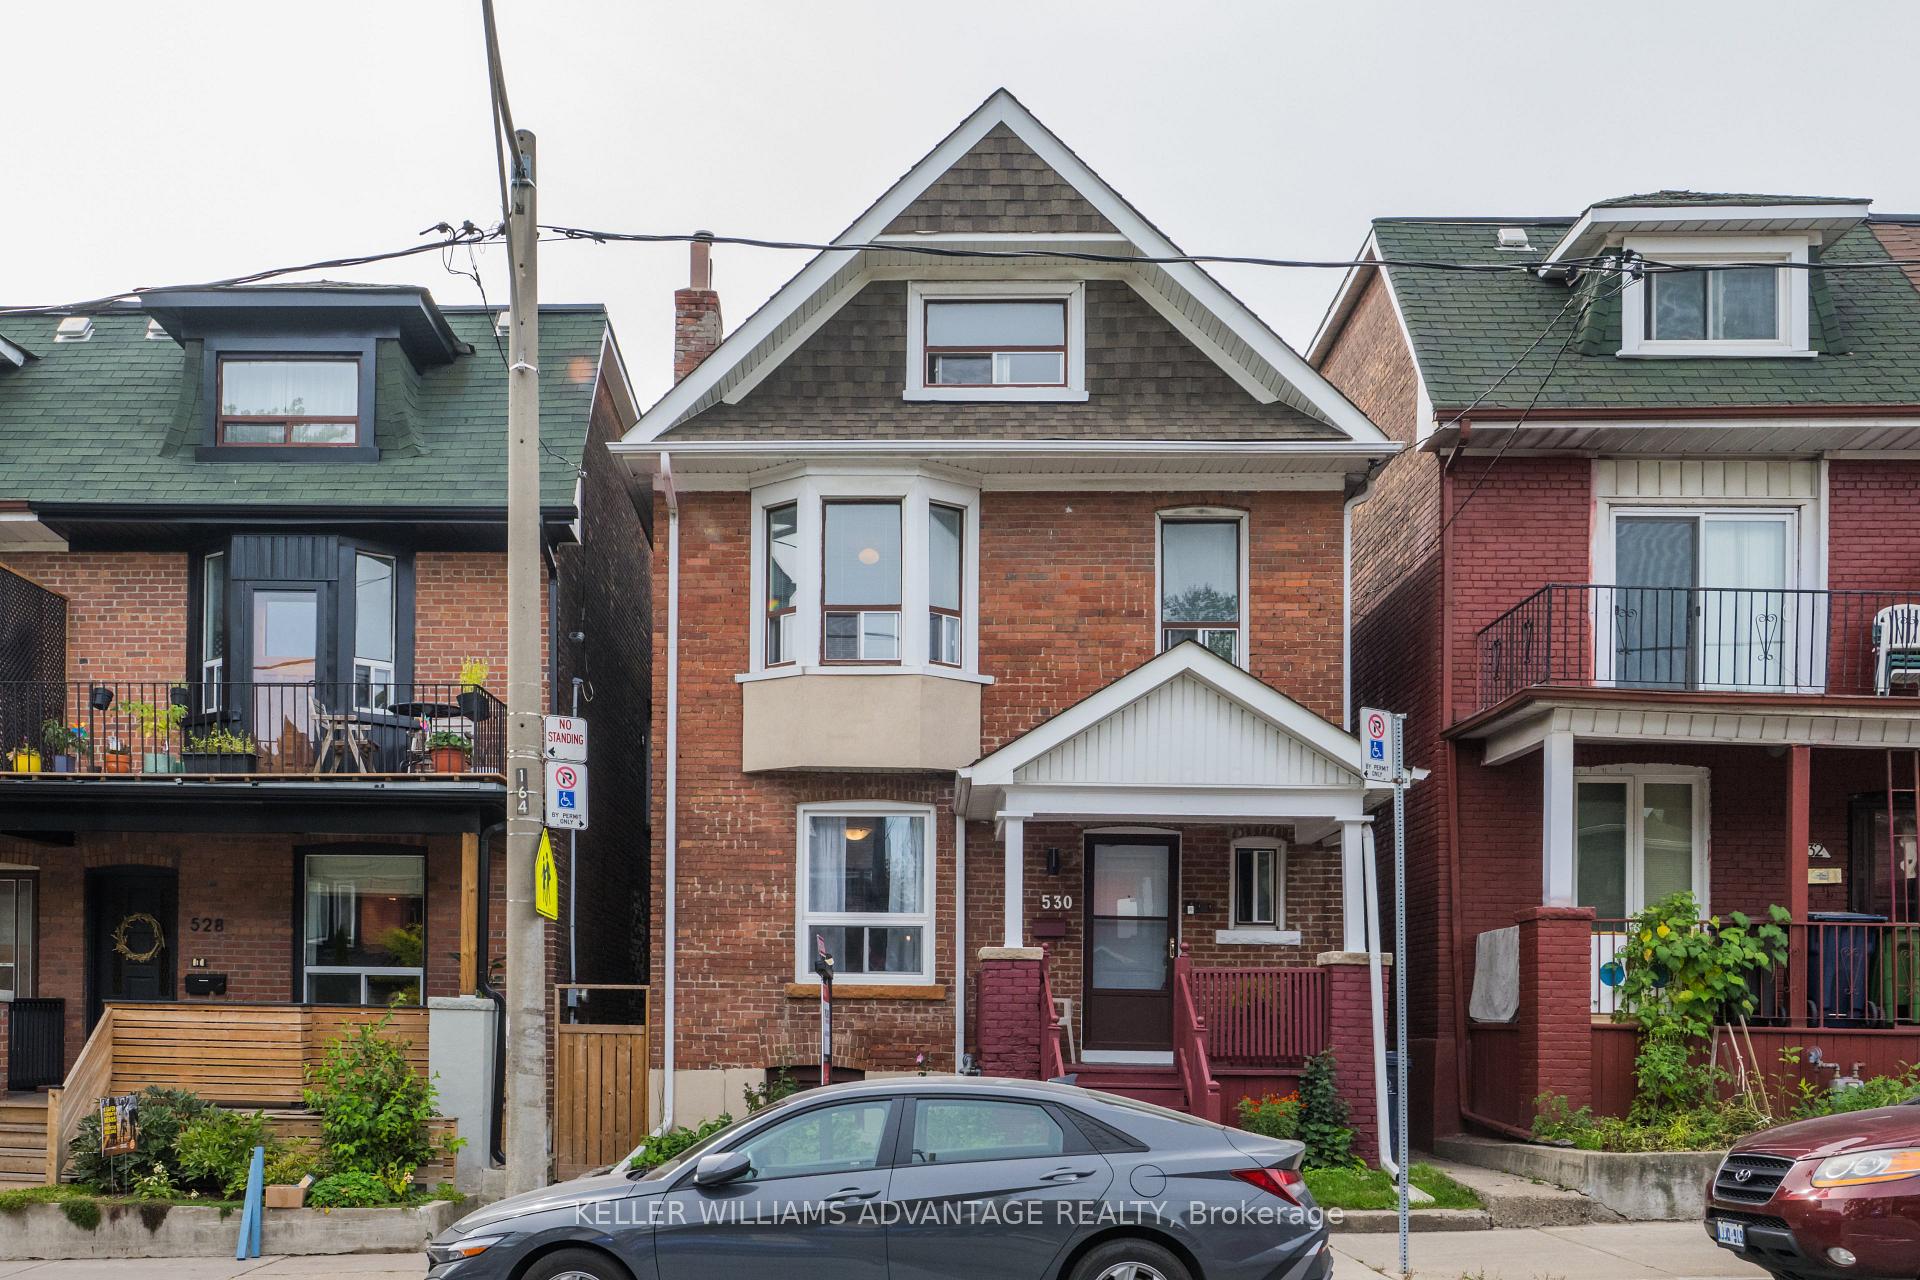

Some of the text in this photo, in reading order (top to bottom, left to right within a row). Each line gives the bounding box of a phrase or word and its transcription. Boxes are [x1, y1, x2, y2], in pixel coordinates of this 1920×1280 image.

[559, 718, 572, 730] NO
[548, 731, 584, 745] STANDING
[1373, 764, 1389, 772] PERMIT
[517, 769, 528, 813] 164
[562, 812, 583, 820] PERMIT
[1041, 895, 1073, 909] 530
[190, 917, 224, 932] 528
